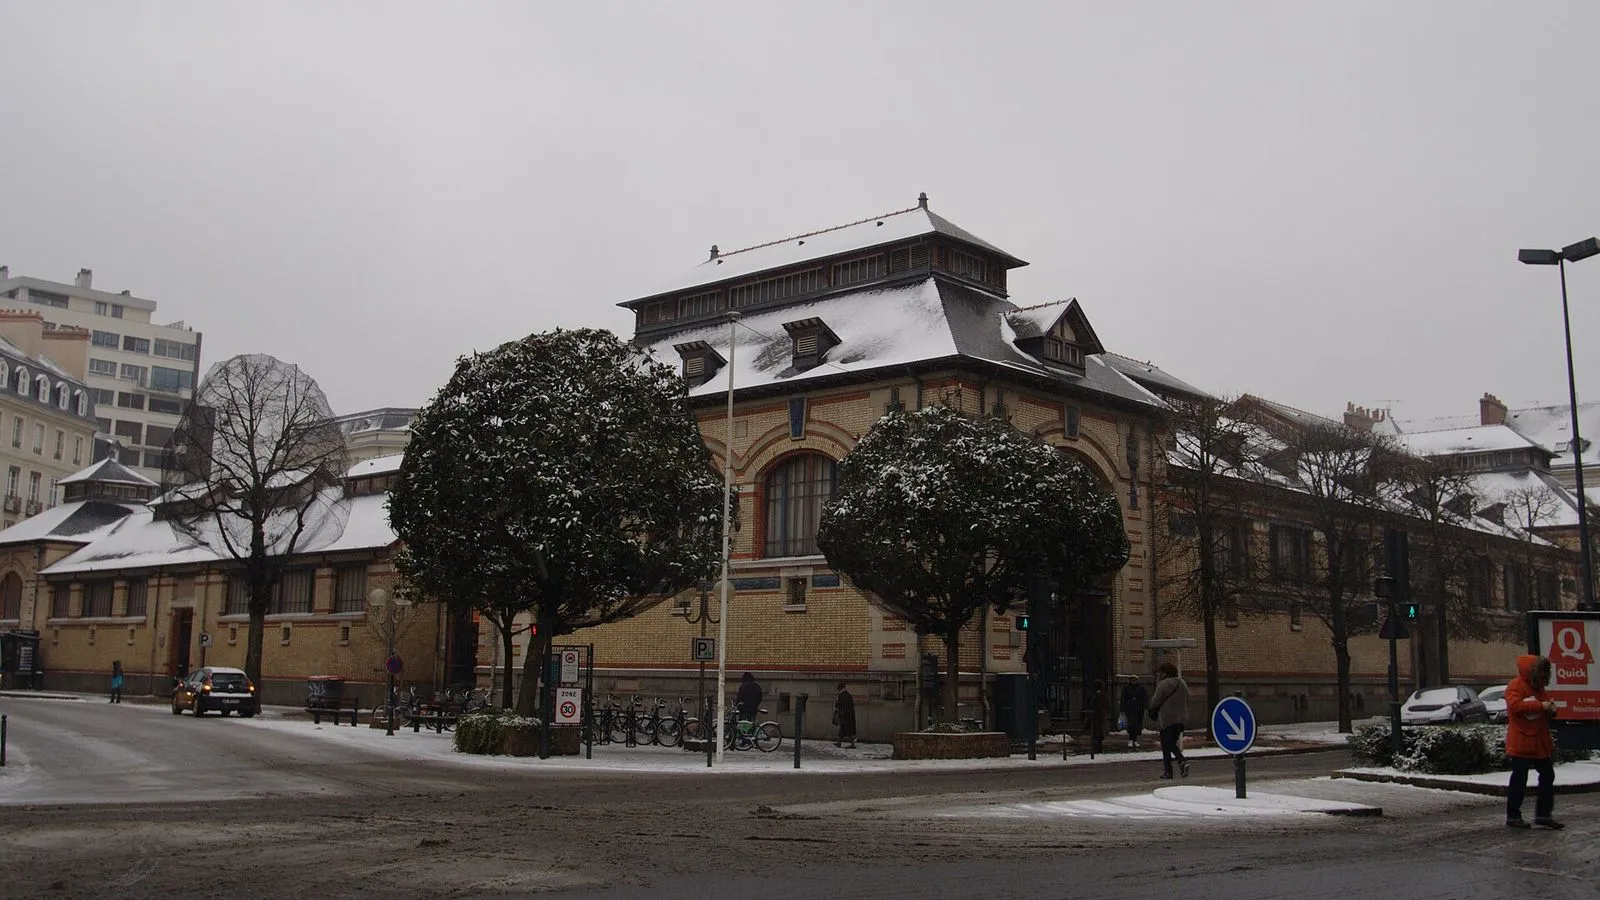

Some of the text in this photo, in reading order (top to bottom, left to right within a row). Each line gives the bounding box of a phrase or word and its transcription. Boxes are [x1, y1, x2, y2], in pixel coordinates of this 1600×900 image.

[698, 642, 707, 656] P
[1557, 627, 1585, 660] Q
[1557, 668, 1587, 678] Quick
[563, 705, 573, 714] 30
